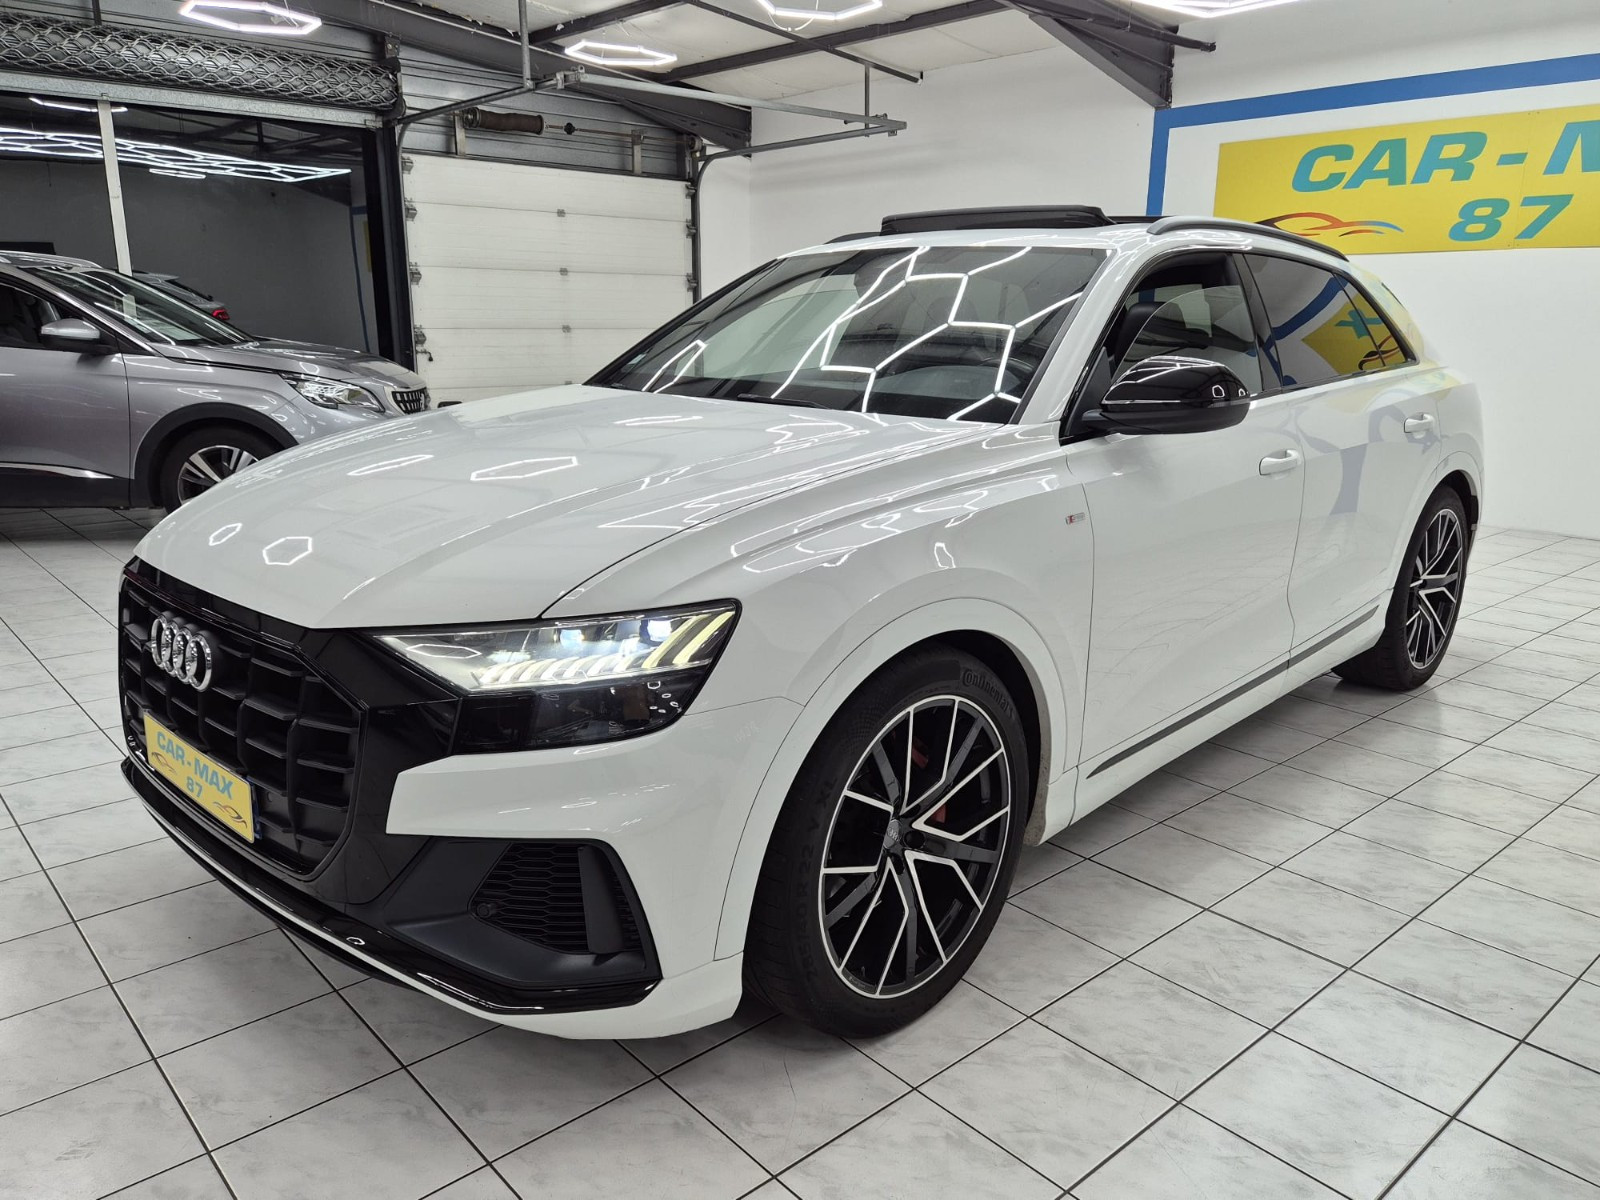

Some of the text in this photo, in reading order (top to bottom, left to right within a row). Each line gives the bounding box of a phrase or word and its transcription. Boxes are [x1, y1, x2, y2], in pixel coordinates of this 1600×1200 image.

[1448, 193, 1574, 242] 87
[962, 667, 1010, 713] Continental
[186, 776, 204, 798] 87
